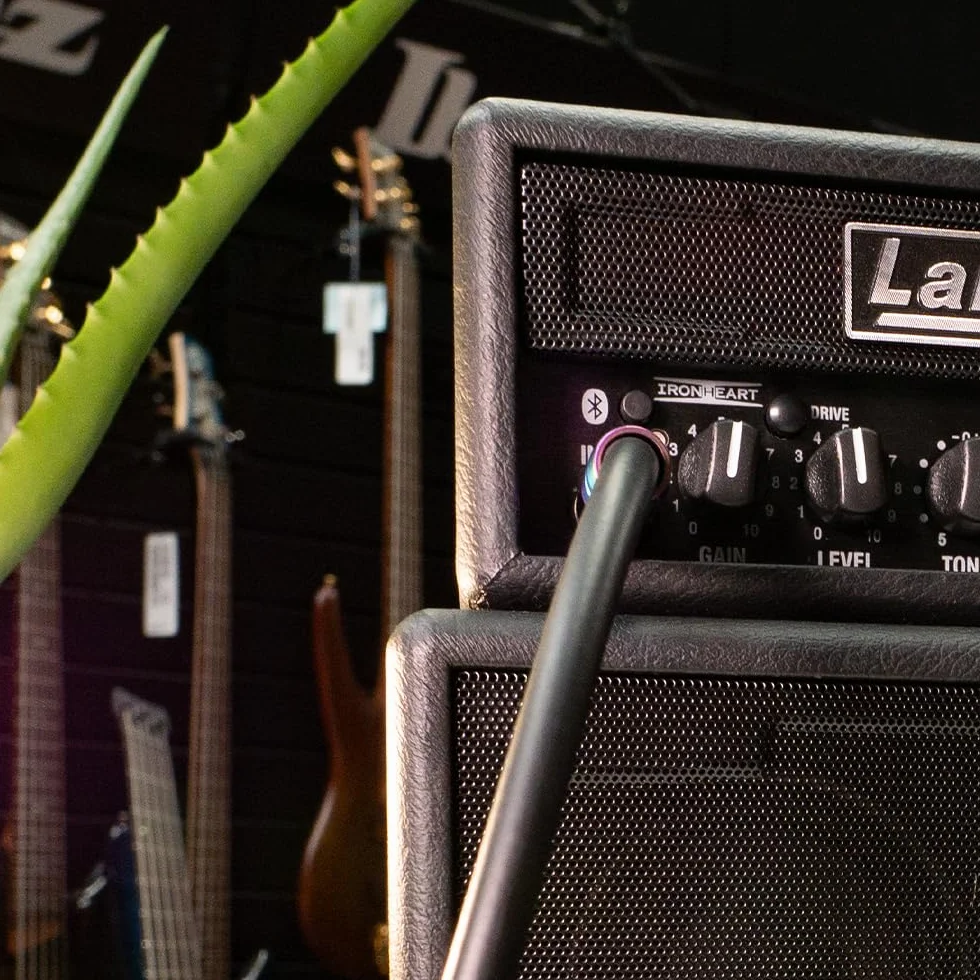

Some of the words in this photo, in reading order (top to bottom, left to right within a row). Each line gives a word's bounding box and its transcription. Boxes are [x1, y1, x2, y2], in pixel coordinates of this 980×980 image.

[656, 383, 760, 401] IRONHEART
[811, 405, 850, 421] DRIVE
[687, 423, 697, 438] 4
[813, 431, 822, 445] 4
[668, 442, 678, 456] 3
[795, 449, 803, 463] 3
[814, 526, 822, 540] 0
[937, 532, 947, 547] 5
[700, 545, 746, 562] GAIN
